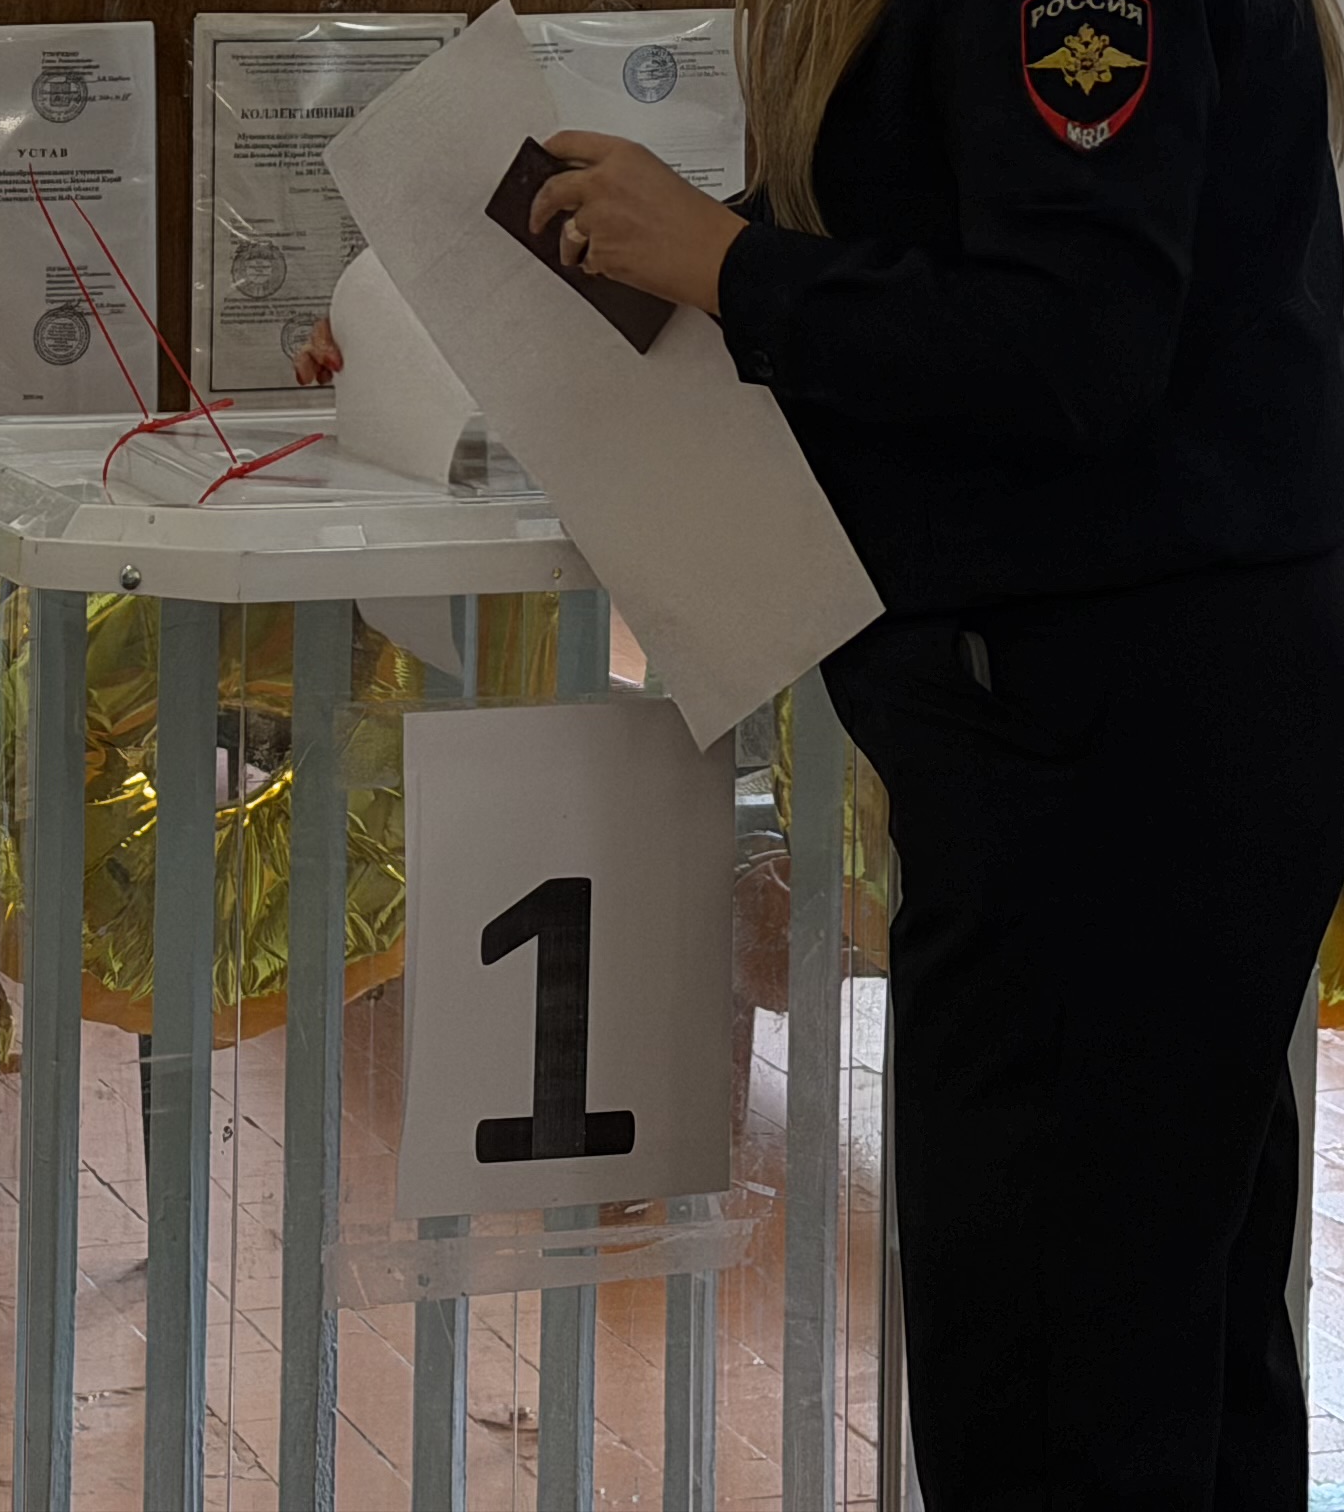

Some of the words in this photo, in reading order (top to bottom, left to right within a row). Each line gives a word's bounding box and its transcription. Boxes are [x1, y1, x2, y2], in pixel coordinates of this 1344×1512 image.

[1066, 119, 1110, 150] МВД
[17, 148, 69, 159] УСТАВ
[475, 876, 635, 1164] 1
